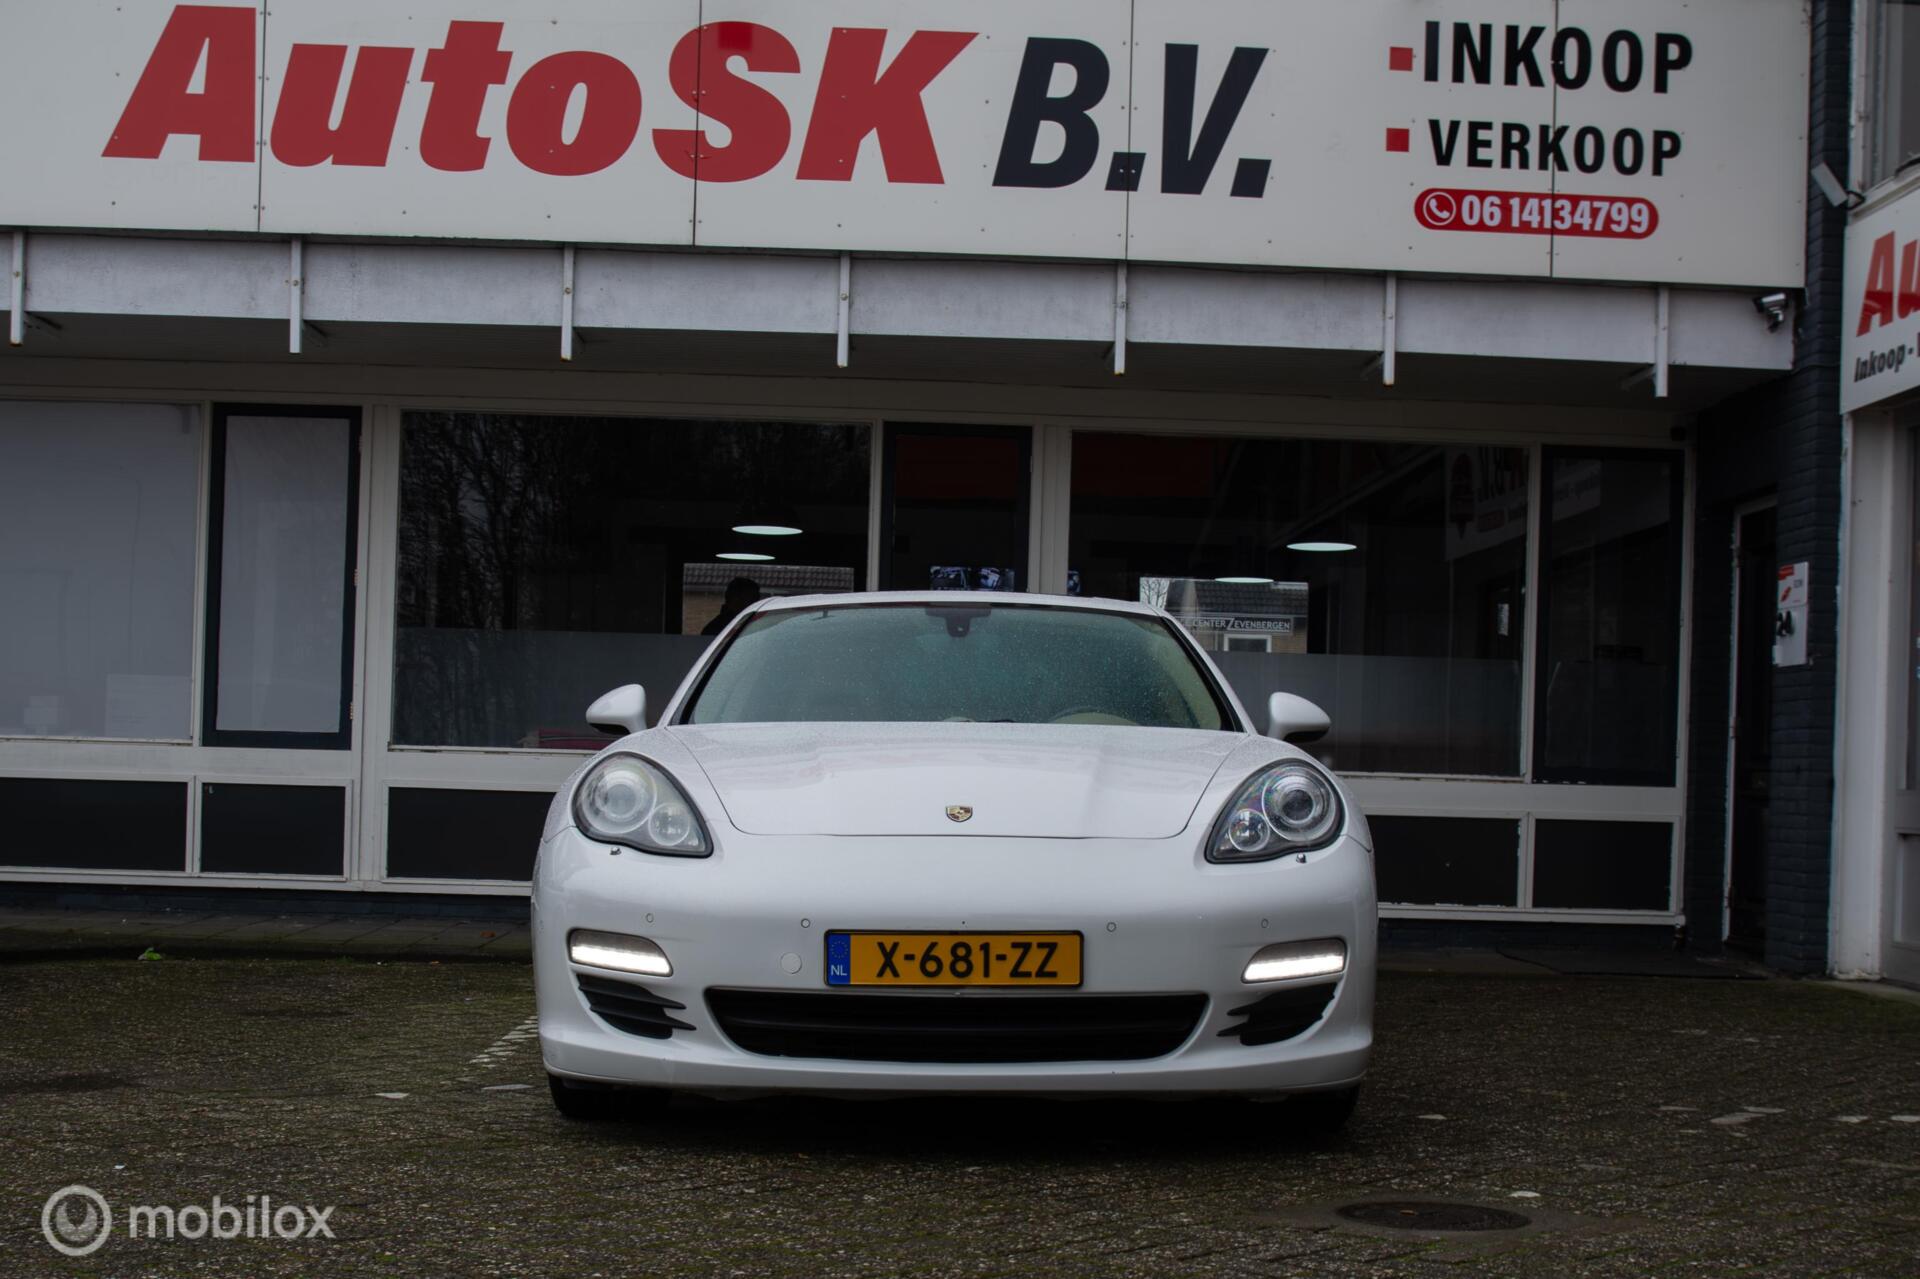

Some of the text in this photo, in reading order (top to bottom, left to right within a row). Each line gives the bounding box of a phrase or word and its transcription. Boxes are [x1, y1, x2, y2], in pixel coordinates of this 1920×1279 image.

[1424, 20, 1693, 94] INKOOP
[101, 4, 1272, 198] AutoSK B.V.
[1428, 118, 1682, 177] VERKOOP
[1461, 194, 1650, 234] 06 14134799
[1854, 344, 1906, 383] Inkoop
[1226, 617, 1291, 632] ZEVENBERGEN
[830, 964, 848, 977] NL
[876, 941, 1058, 979] X-681-ZZ
